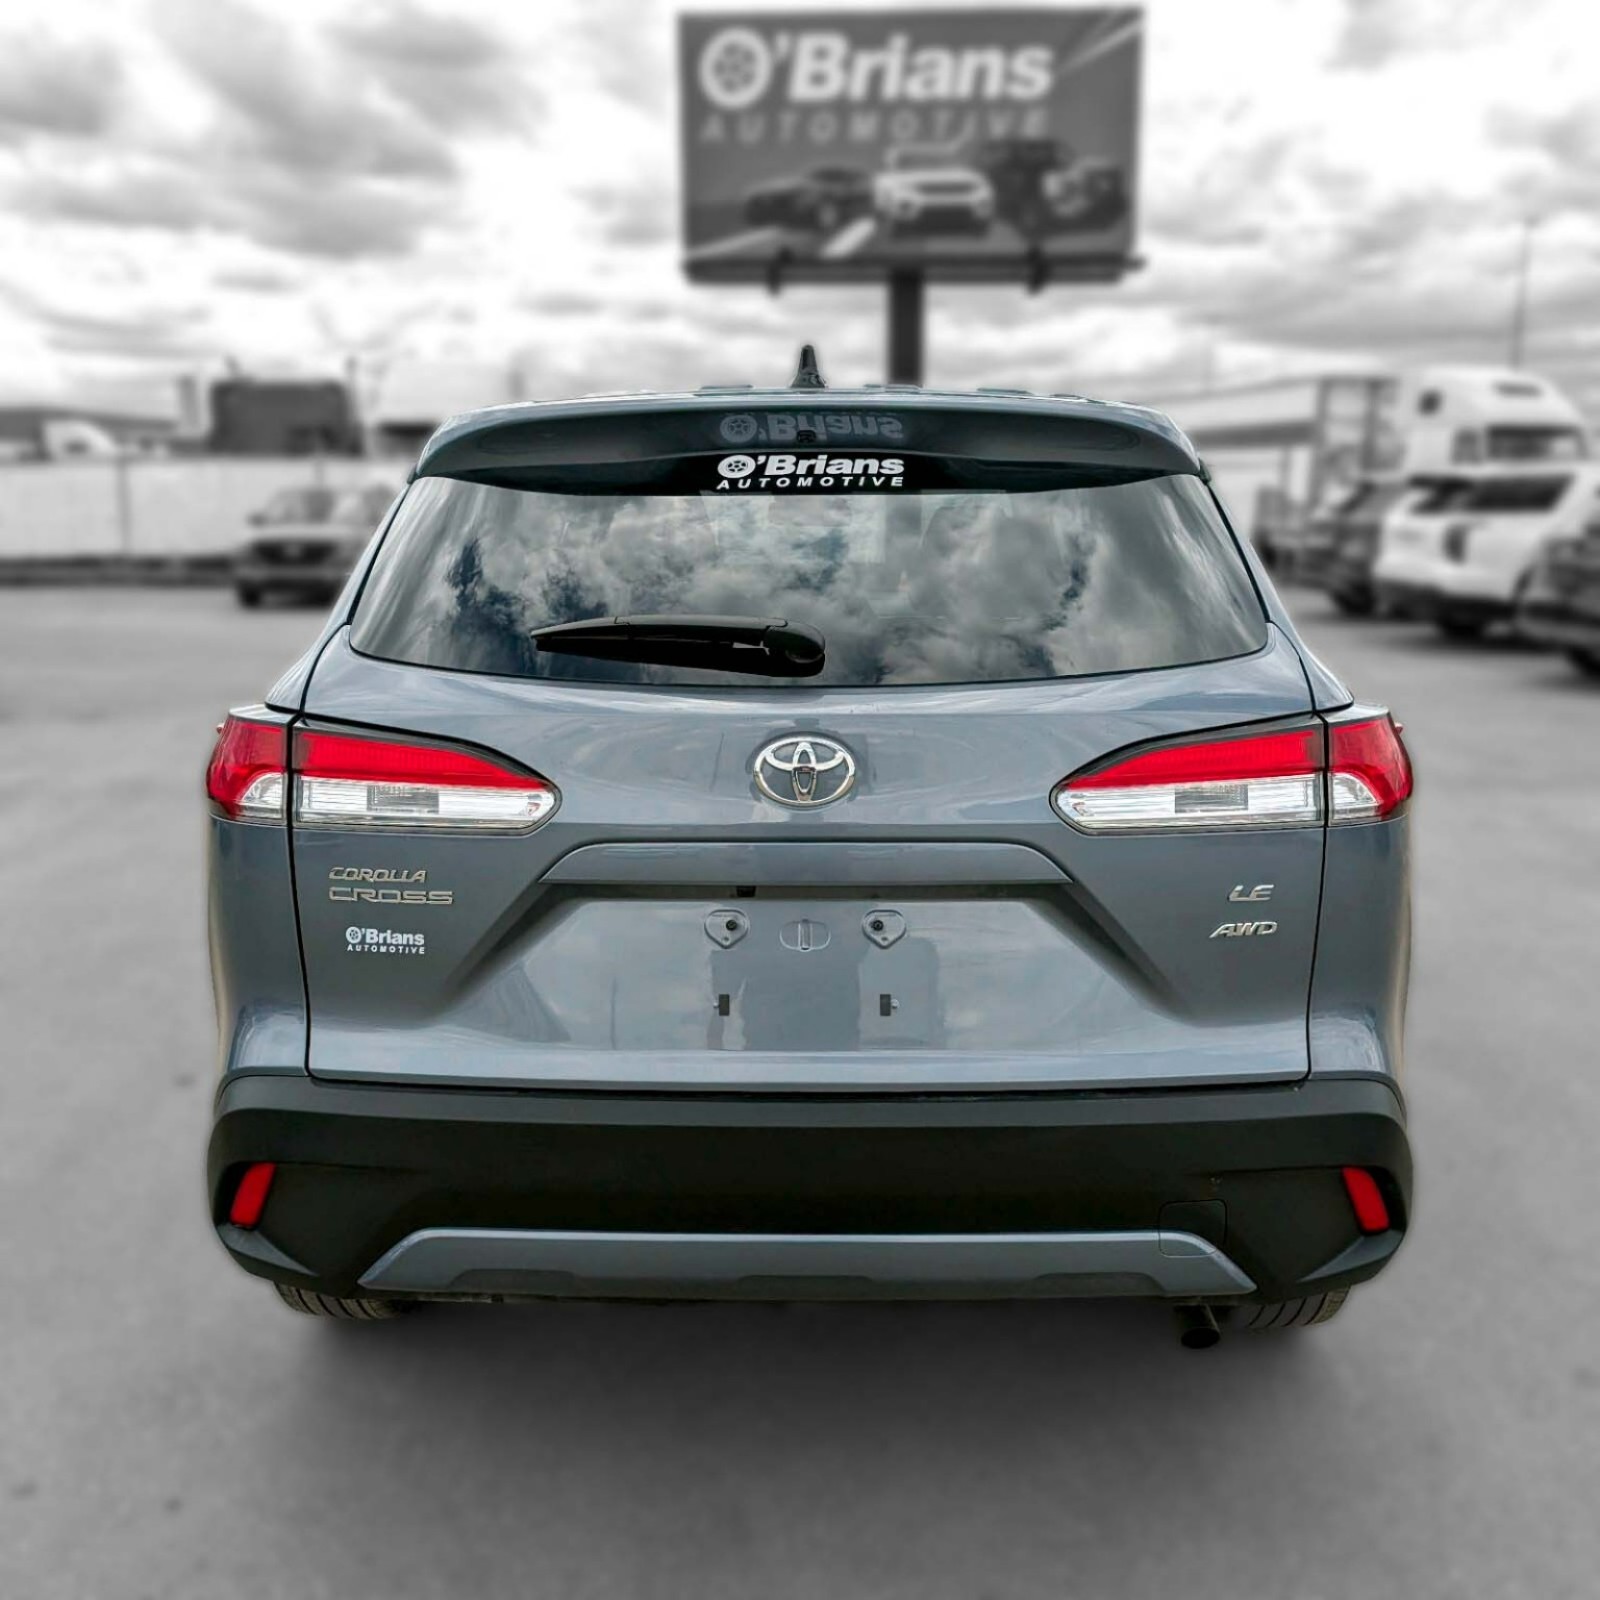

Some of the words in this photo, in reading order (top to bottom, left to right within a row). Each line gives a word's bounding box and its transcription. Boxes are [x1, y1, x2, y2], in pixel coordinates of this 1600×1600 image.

[700, 27, 1055, 110] O'Brians
[702, 109, 1048, 144] AUTOMOTIVE
[717, 454, 905, 478] O'Brians
[716, 477, 904, 490] AUTOMOTIVE
[328, 867, 427, 883] COROLLA
[328, 887, 453, 905] CROSS
[1228, 884, 1275, 902] LE
[345, 926, 425, 945] O'Brians
[1208, 921, 1278, 939] AWD
[346, 944, 425, 955] AUTOMOTIVE
